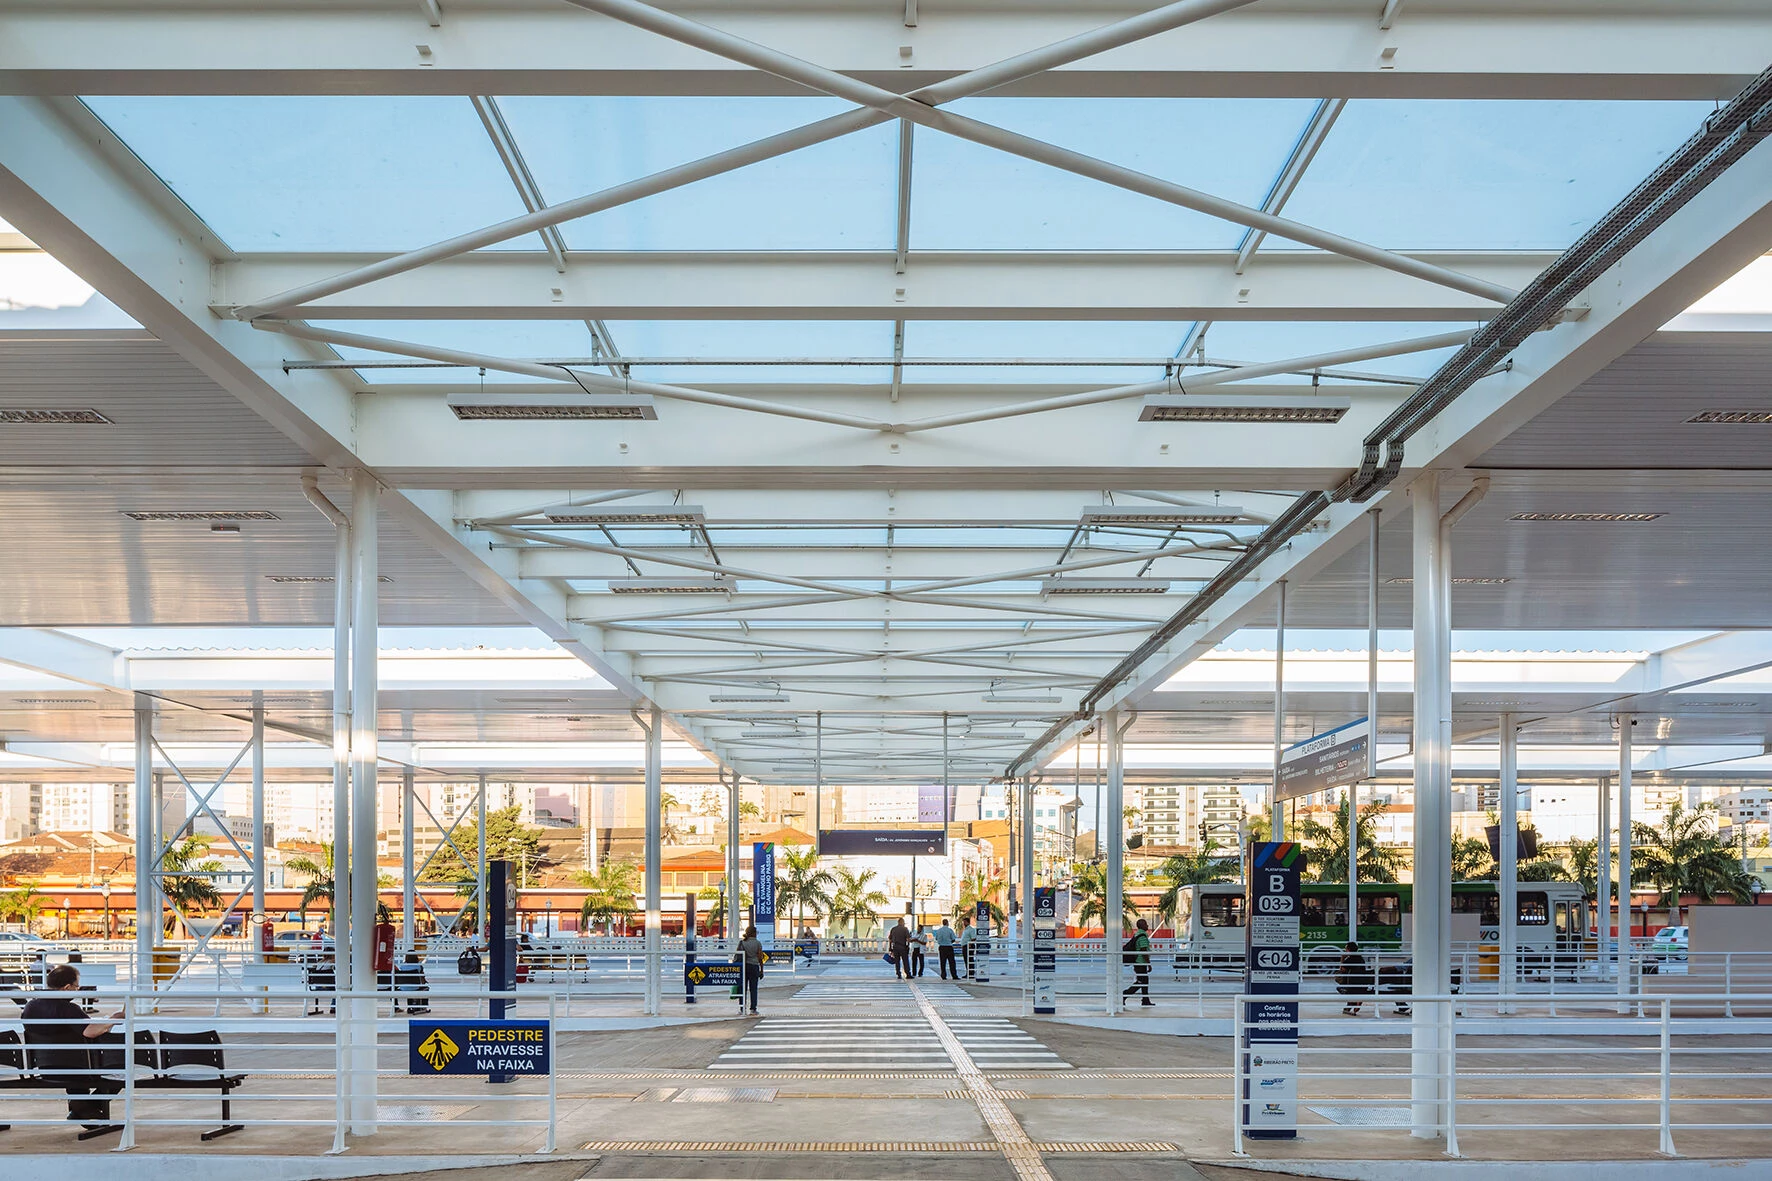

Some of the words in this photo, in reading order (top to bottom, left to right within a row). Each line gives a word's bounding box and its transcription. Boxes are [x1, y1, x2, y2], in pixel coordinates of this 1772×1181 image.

[1302, 738, 1330, 754] PLATAFORMA
[1270, 875, 1284, 892] B
[1262, 898, 1281, 910] 03
[1272, 952, 1290, 965] 04
[468, 1030, 543, 1041] PEDESTRE
[468, 1045, 543, 1055] ATRAVESSE
[477, 1060, 495, 1070] NA
[498, 1060, 534, 1070] FAIXA
